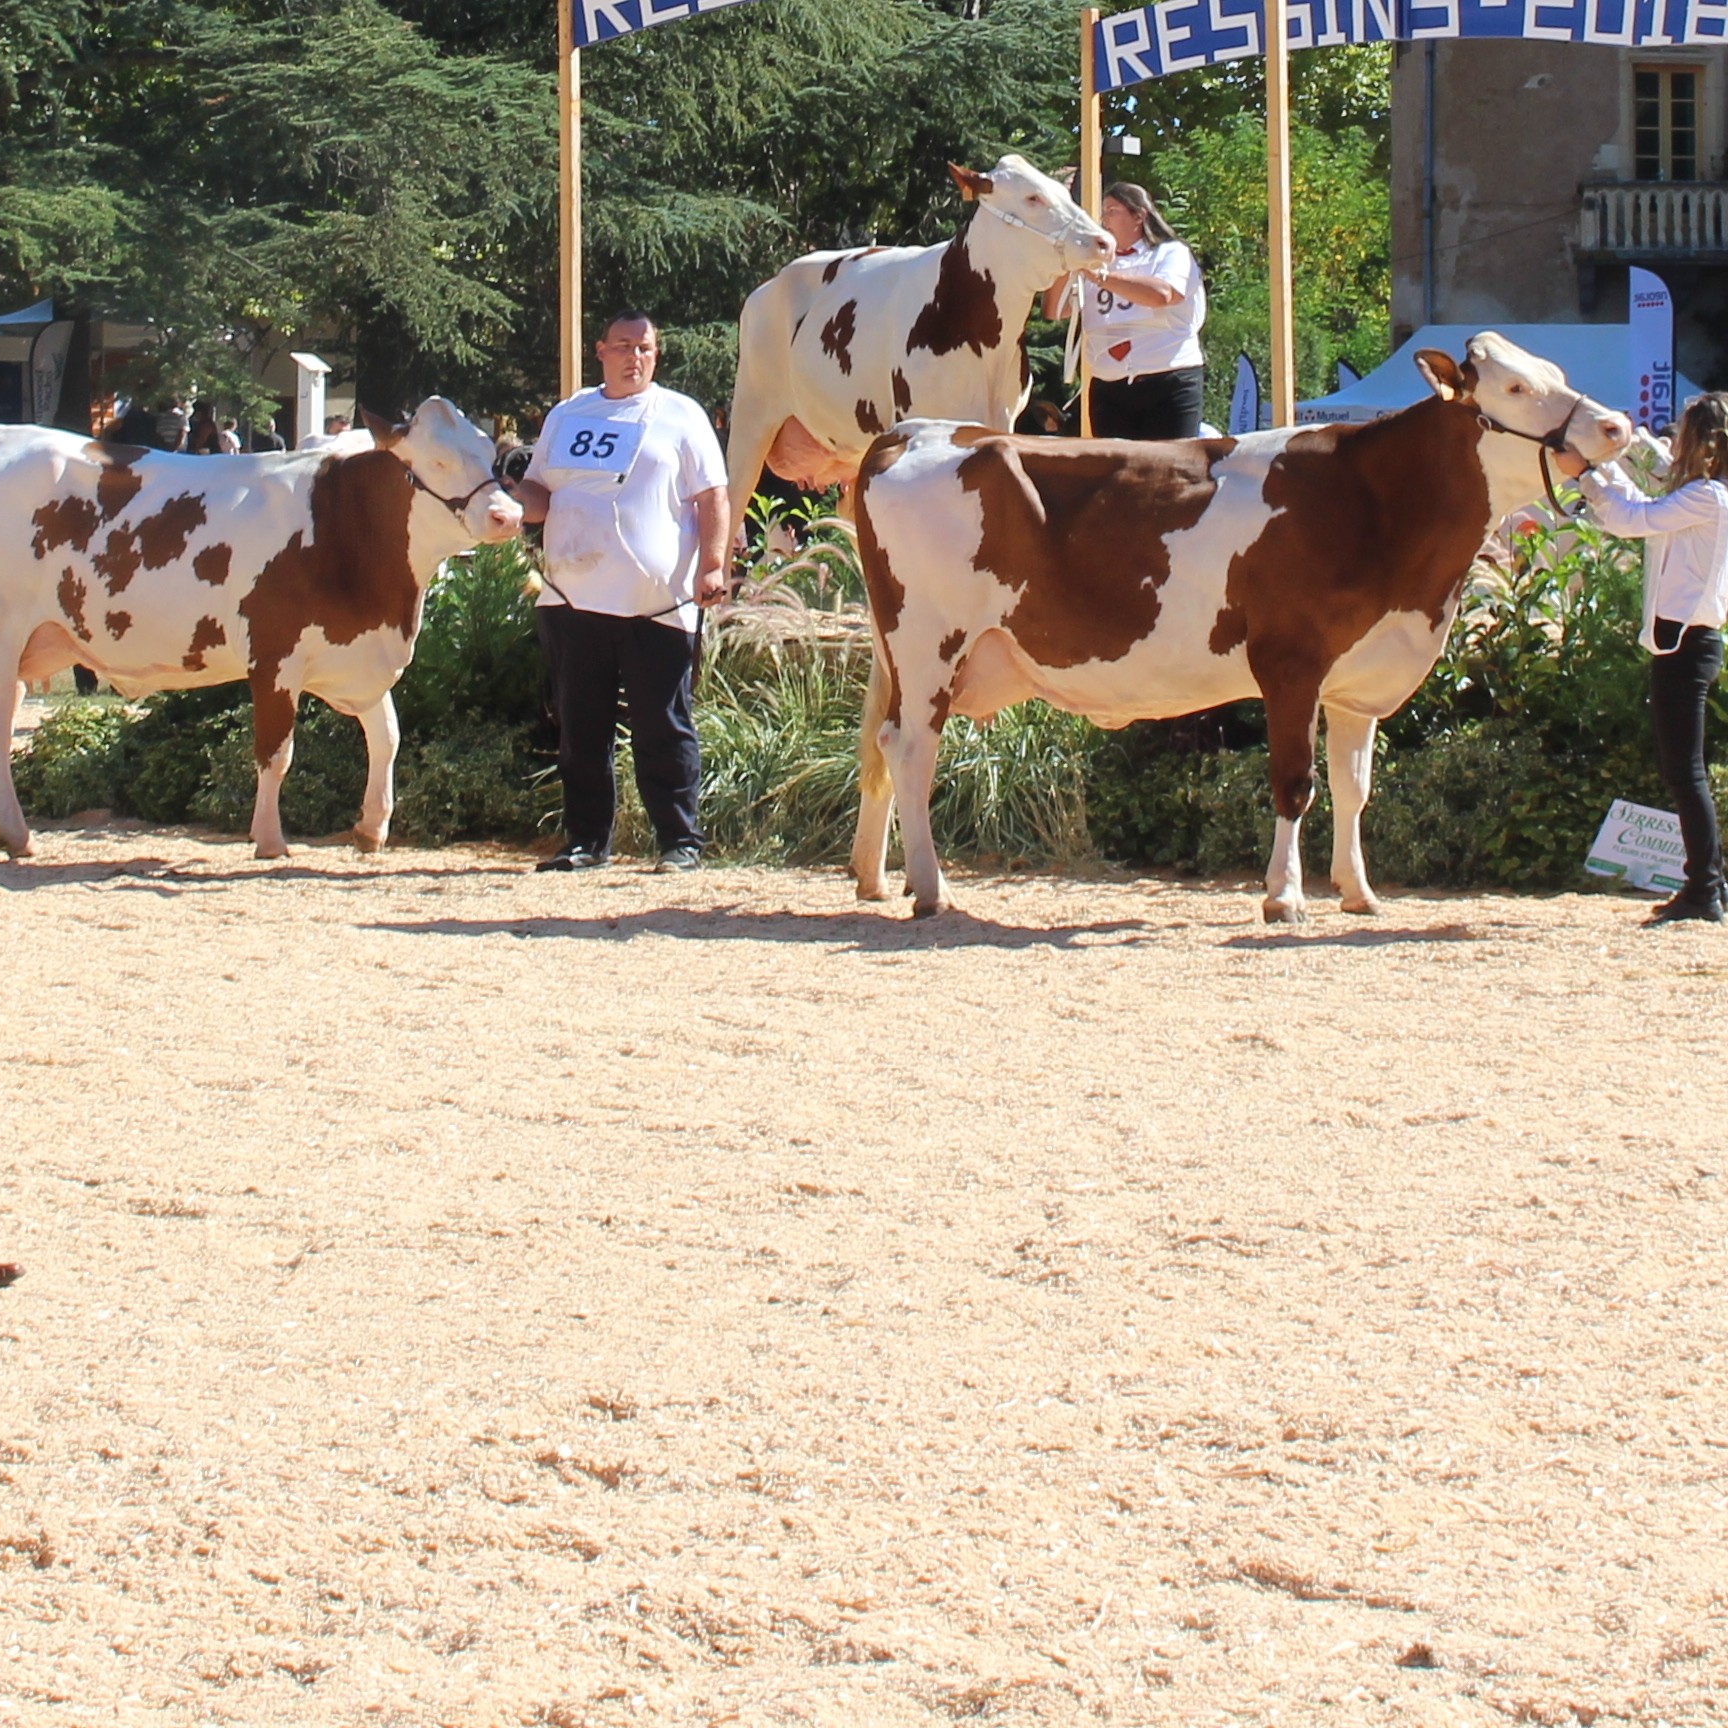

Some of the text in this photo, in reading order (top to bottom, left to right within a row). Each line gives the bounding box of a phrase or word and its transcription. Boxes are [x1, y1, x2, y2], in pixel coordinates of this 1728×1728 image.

[1316, 410, 1350, 421] Mutuel
[569, 429, 620, 460] 85
[1610, 804, 1678, 833] SERRES
